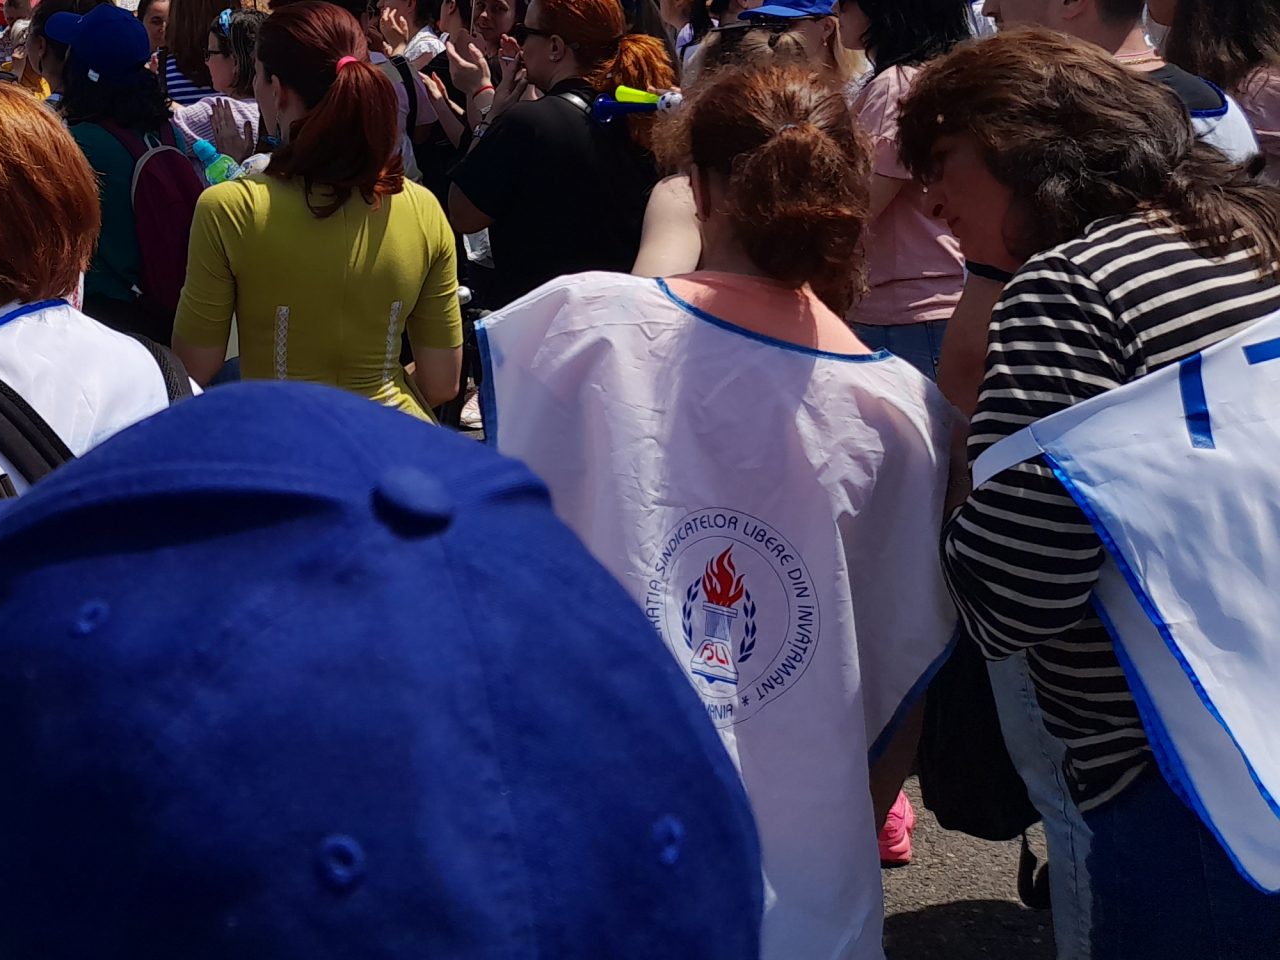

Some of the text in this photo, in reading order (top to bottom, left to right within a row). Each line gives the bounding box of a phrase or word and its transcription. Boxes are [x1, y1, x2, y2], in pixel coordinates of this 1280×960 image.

[655, 513, 739, 577] SINDICATELOR
[743, 521, 794, 566] LIBERE
[788, 568, 809, 598] DIN
